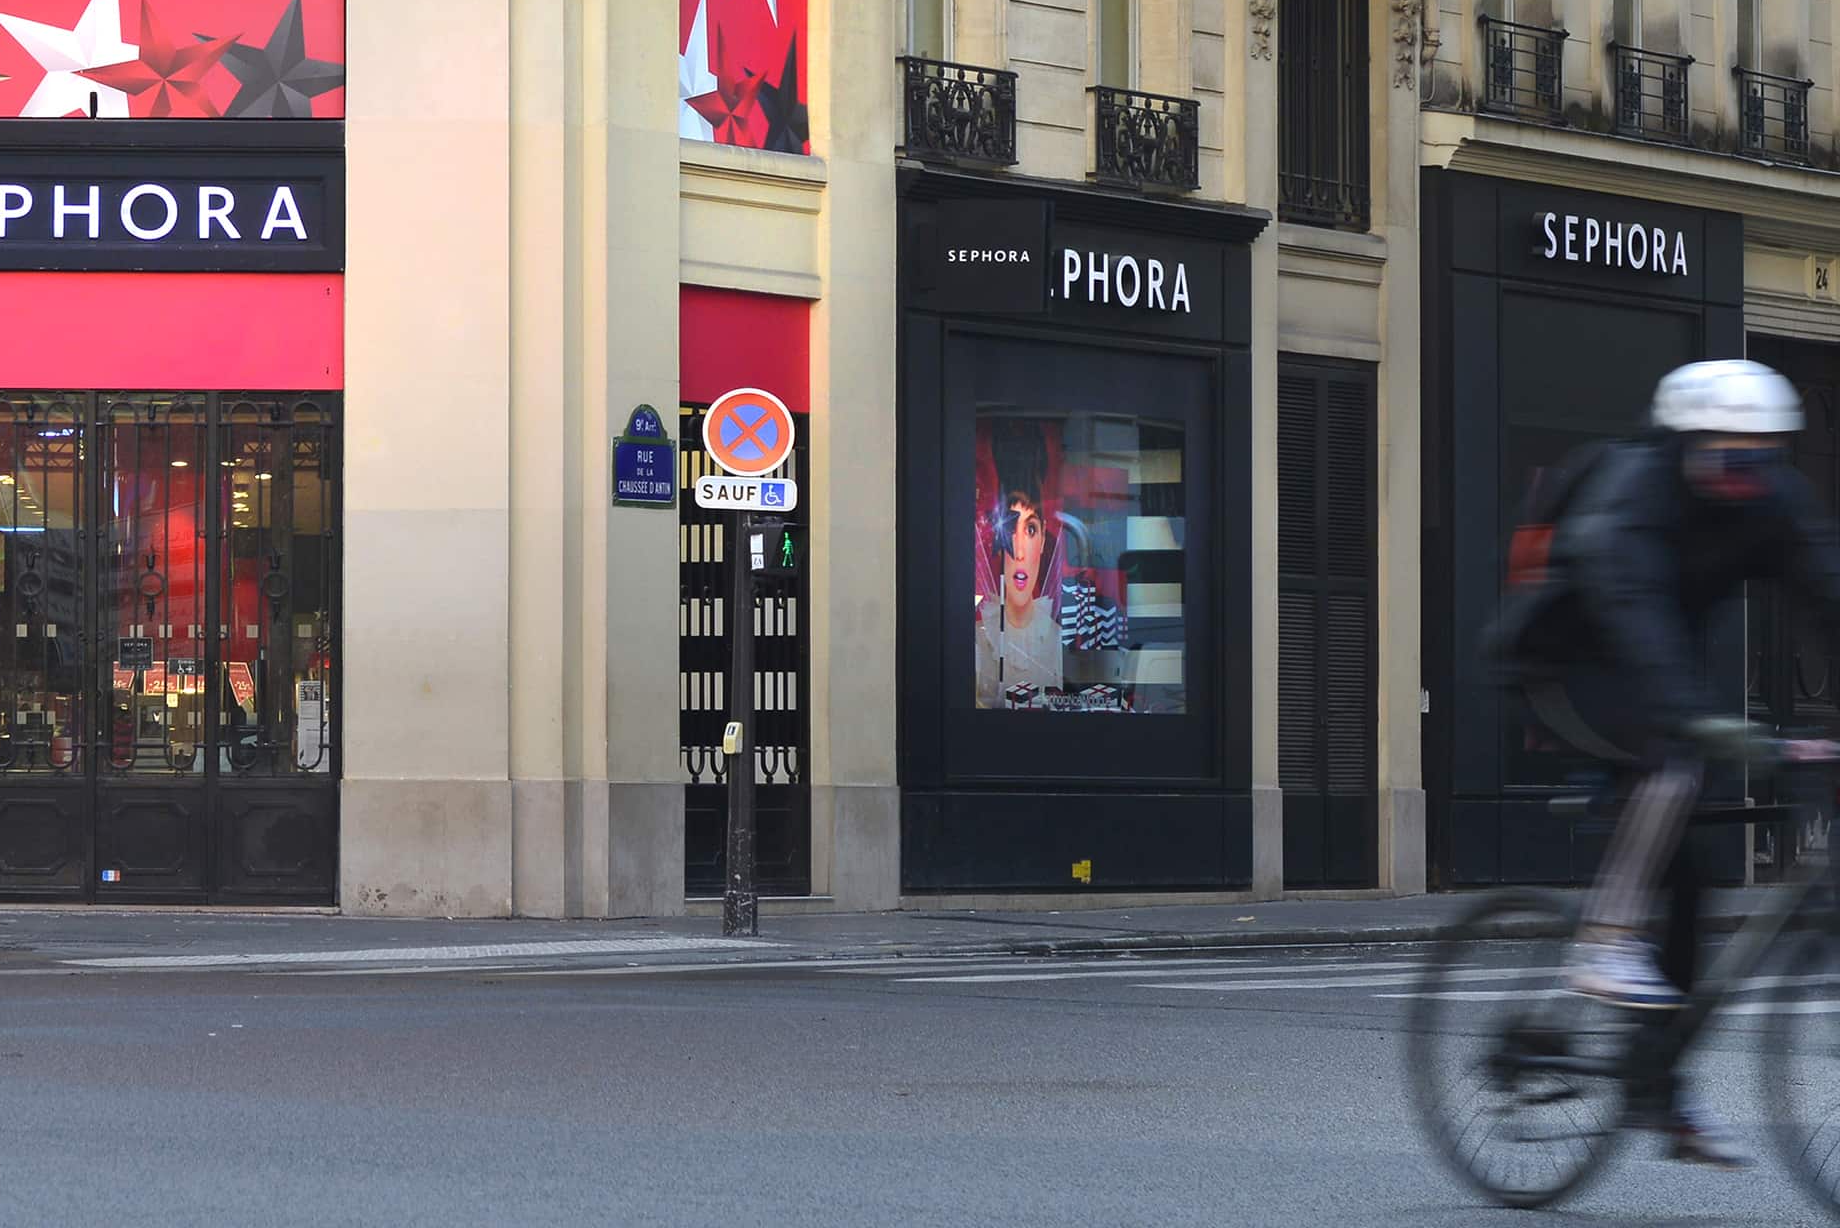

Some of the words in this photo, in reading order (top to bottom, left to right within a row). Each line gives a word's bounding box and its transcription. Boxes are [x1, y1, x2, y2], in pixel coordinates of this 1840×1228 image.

[1544, 212, 1688, 276] SEPHORA
[947, 250, 1031, 263] SEPHORA
[1050, 249, 1191, 313] PHORA
[1815, 267, 1828, 290] 24
[637, 451, 654, 463] RUE
[637, 468, 644, 476] DE
[646, 468, 654, 476] LA
[703, 484, 757, 501] SAUF
